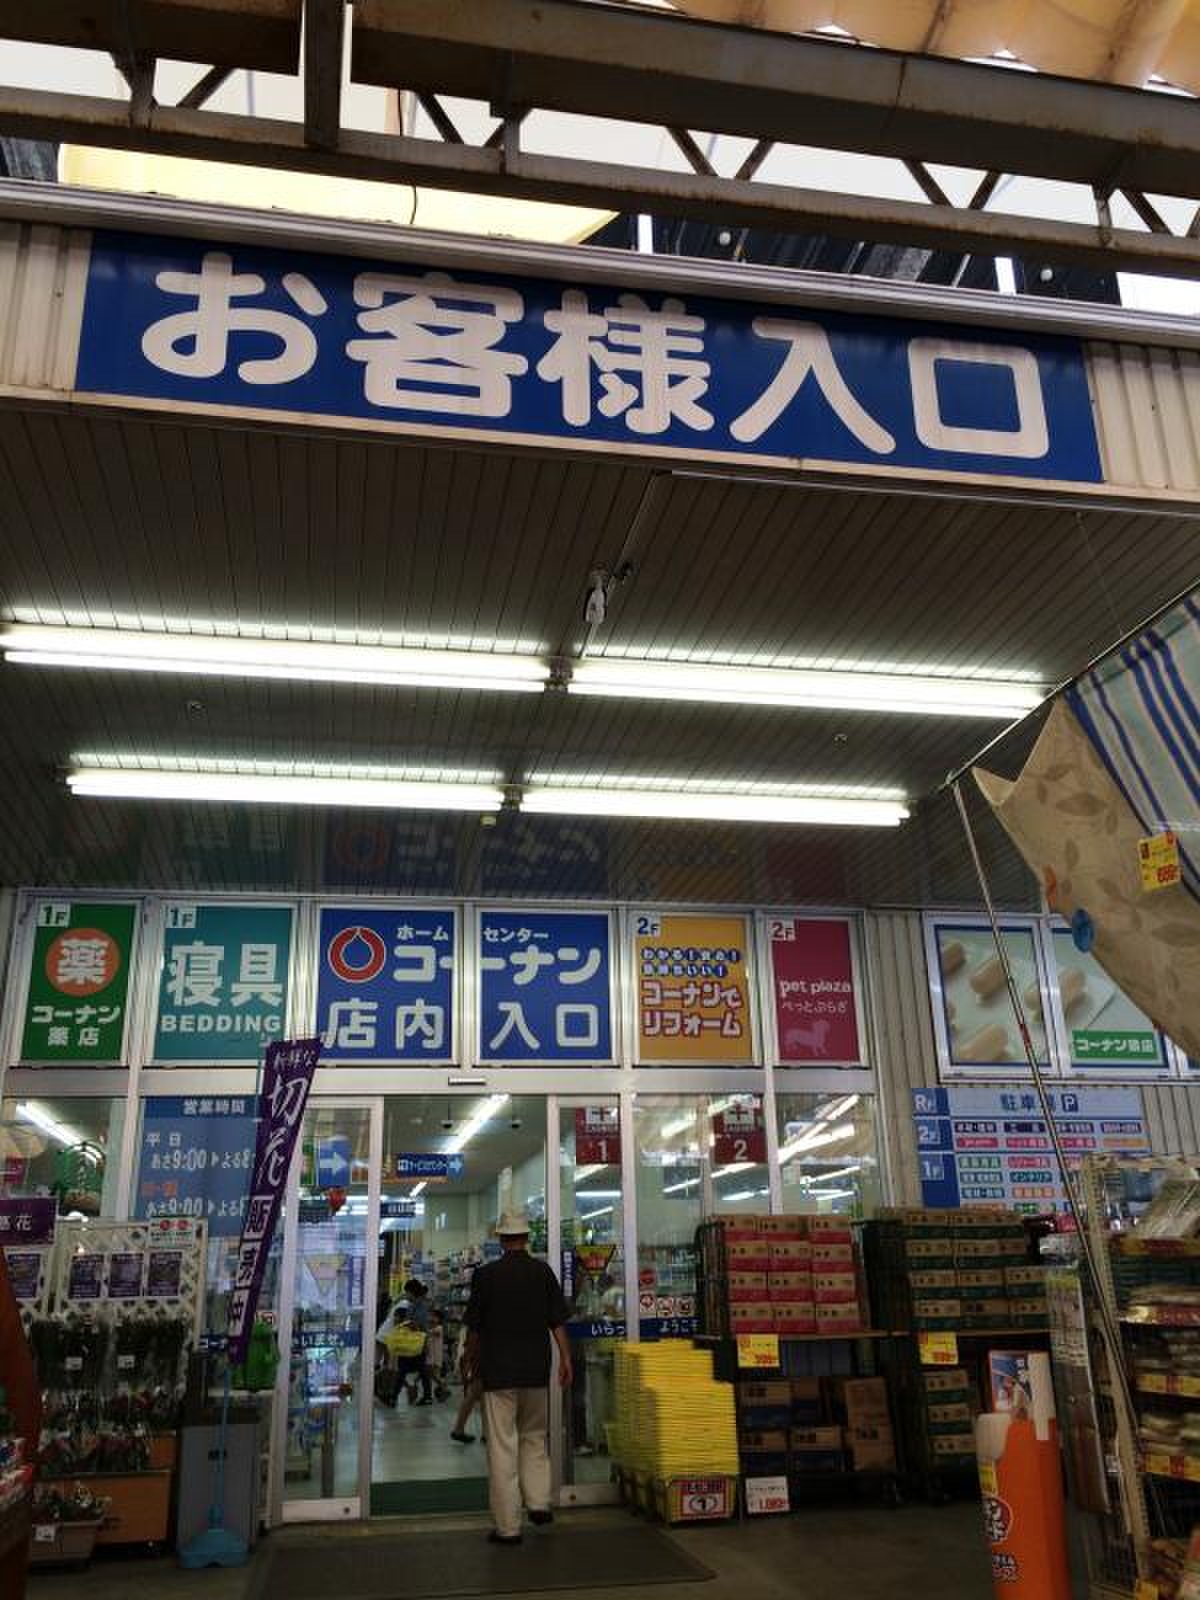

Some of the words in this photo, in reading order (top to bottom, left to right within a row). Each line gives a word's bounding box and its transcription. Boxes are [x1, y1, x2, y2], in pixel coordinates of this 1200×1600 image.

[141, 251, 1050, 459] お客様入口
[43, 907, 67, 926] 1F
[170, 908, 193, 927] 1F
[638, 918, 660, 935] 2F
[771, 921, 794, 940] 2F
[57, 939, 109, 985] 薬
[166, 940, 283, 1008] 寝具
[642, 980, 742, 1008] コーナンで
[780, 980, 806, 997] pet
[32, 1004, 121, 1024] コーナン
[160, 1014, 282, 1034] BEDDING
[643, 1011, 742, 1037] リフォーム
[183, 1098, 245, 1115] 営業時間
[597, 1140, 608, 1160] 1
[734, 1139, 748, 1160] 2
